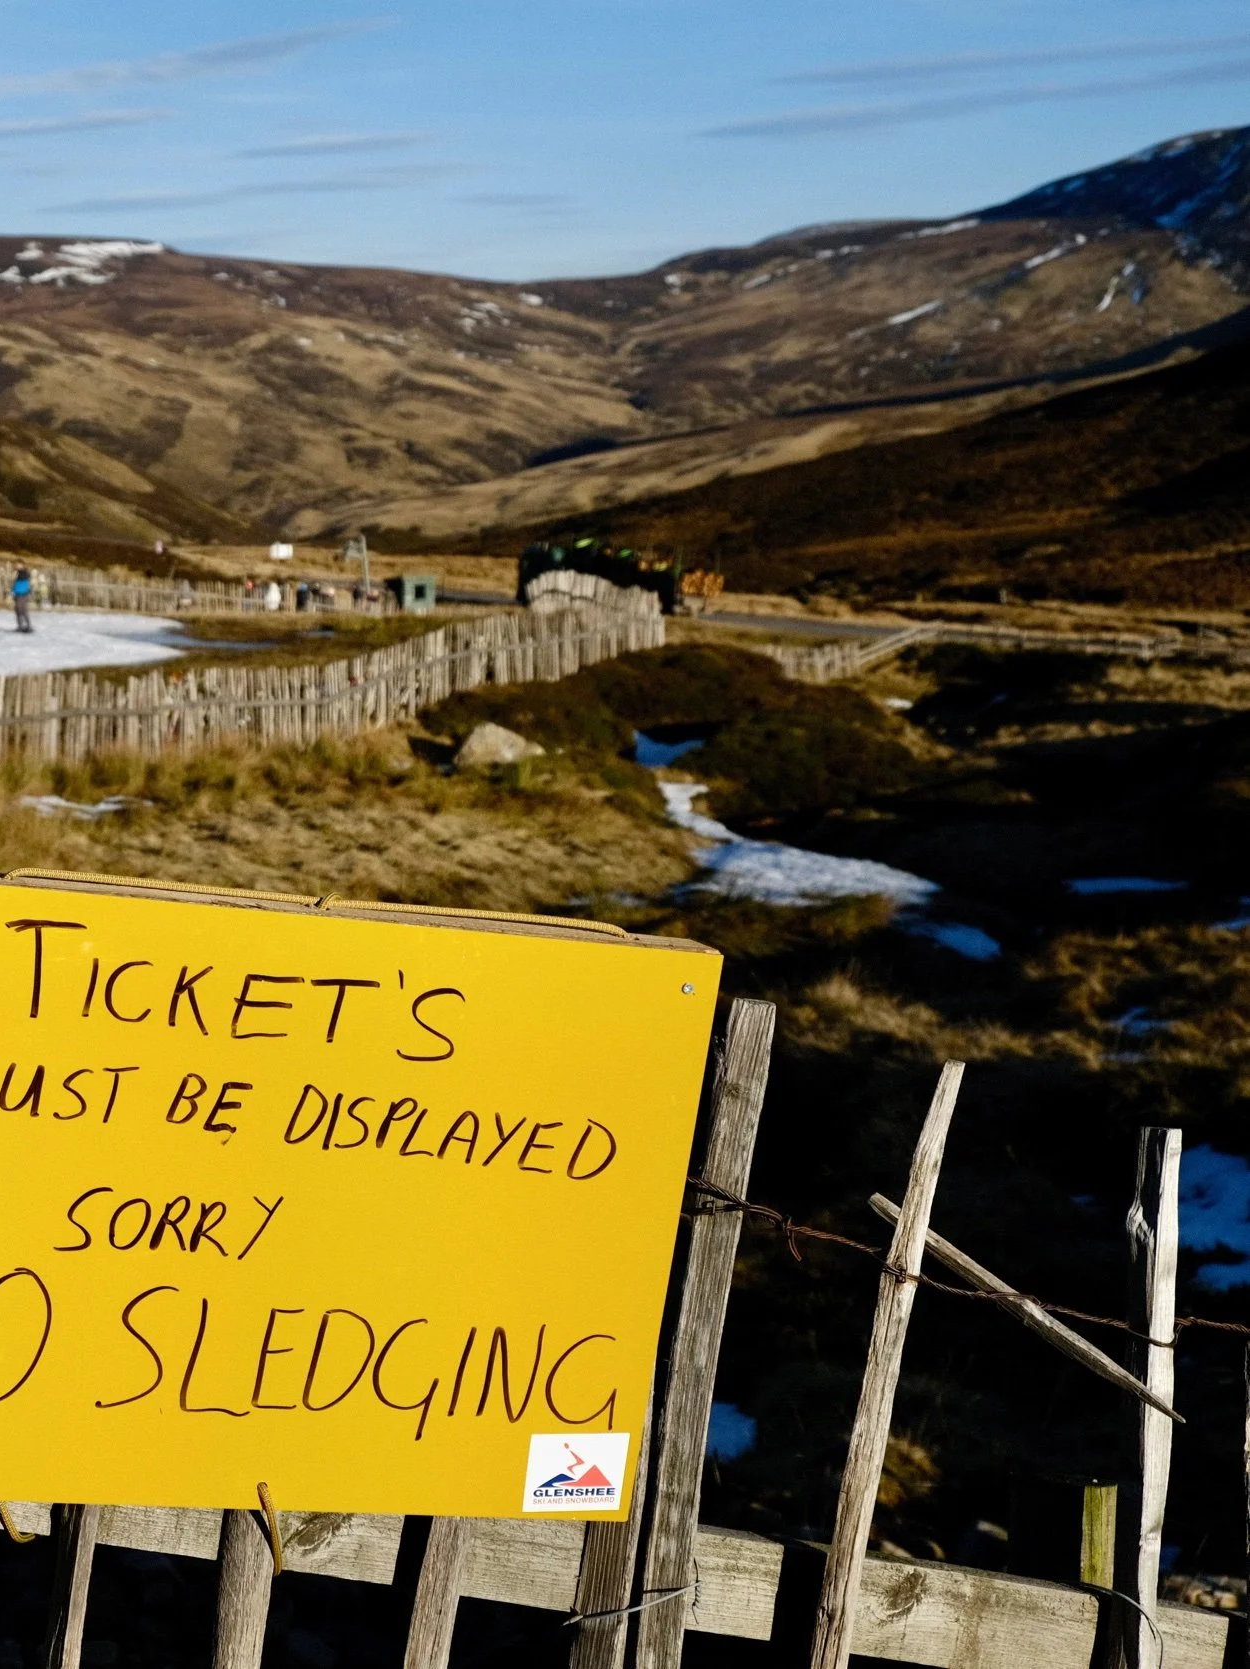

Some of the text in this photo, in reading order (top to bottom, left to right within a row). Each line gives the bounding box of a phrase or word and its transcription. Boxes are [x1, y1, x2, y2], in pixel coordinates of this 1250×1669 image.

[6, 919, 466, 1062] TICKET'S
[166, 1073, 254, 1134] BE
[284, 1084, 617, 1181] DISPLAYED
[54, 1187, 284, 1260] SORRY
[95, 1286, 617, 1442] SLEDGING
[533, 1487, 616, 1497] GLENSHEE
[565, 1496, 615, 1504] SNOWBOARD
